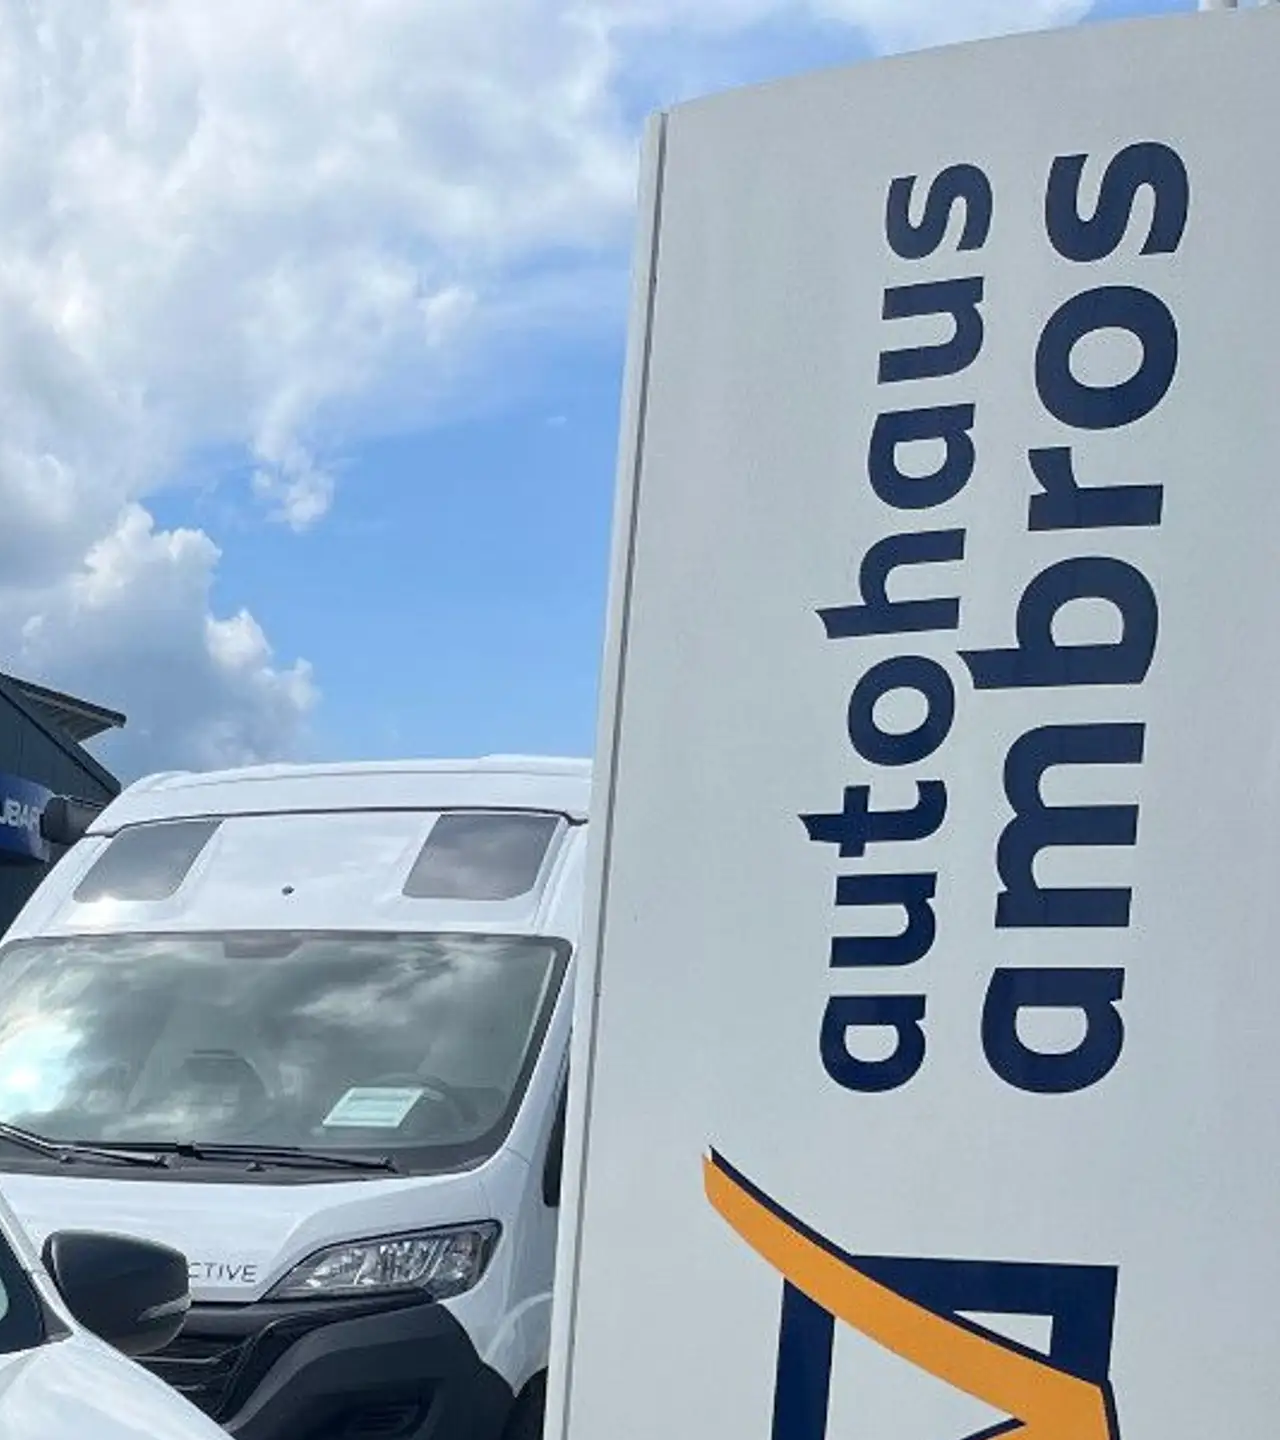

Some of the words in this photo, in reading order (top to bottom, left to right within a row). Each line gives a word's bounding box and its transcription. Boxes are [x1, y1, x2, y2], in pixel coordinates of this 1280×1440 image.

[797, 163, 994, 1094] autohaus
[954, 141, 1190, 1094] ambros
[187, 1262, 257, 1283] CTIVE
